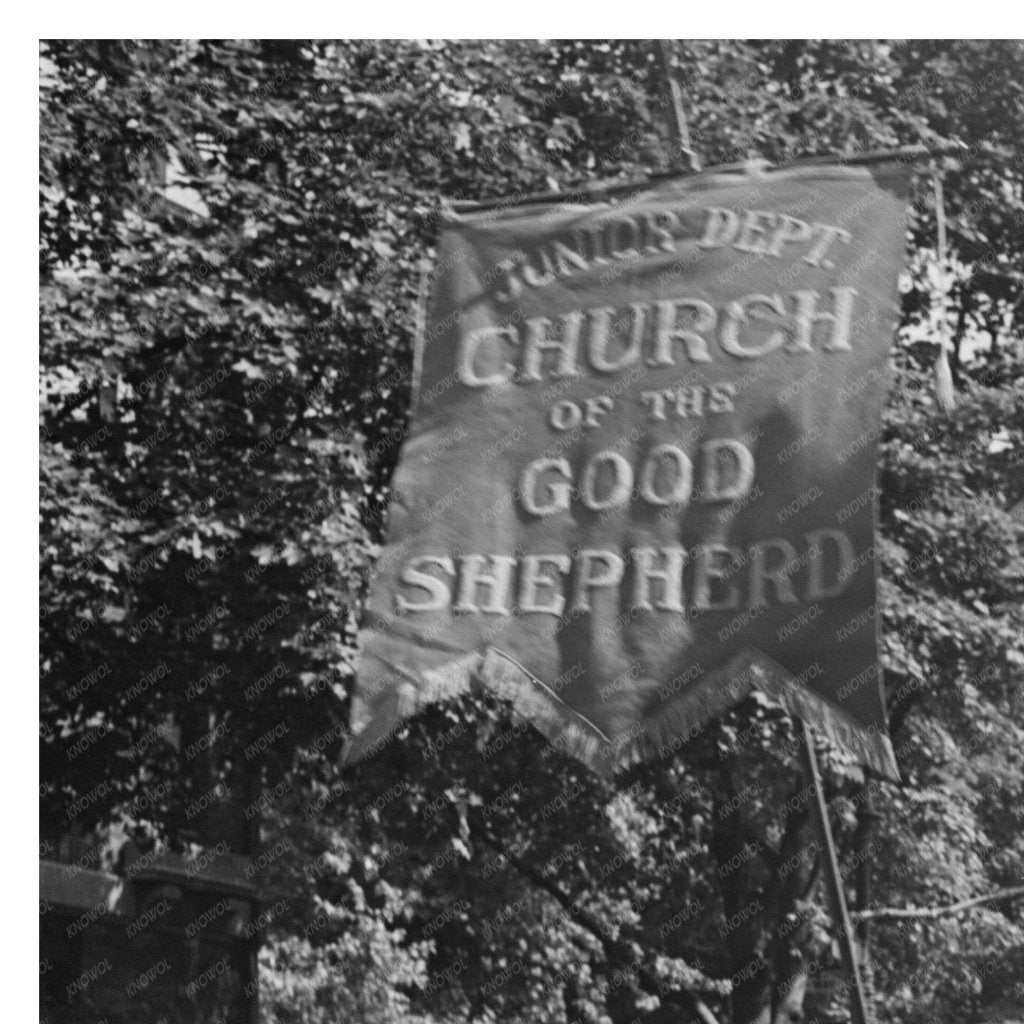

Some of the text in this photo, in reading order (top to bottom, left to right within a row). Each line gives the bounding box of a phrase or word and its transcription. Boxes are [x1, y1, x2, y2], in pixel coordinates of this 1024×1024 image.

[496, 206, 853, 299] JUNIOR DEPT.
[458, 286, 859, 387] CHURCH
[549, 382, 738, 431] OF THE
[520, 437, 756, 517] GOOD
[396, 528, 857, 618] SHEPHERD
